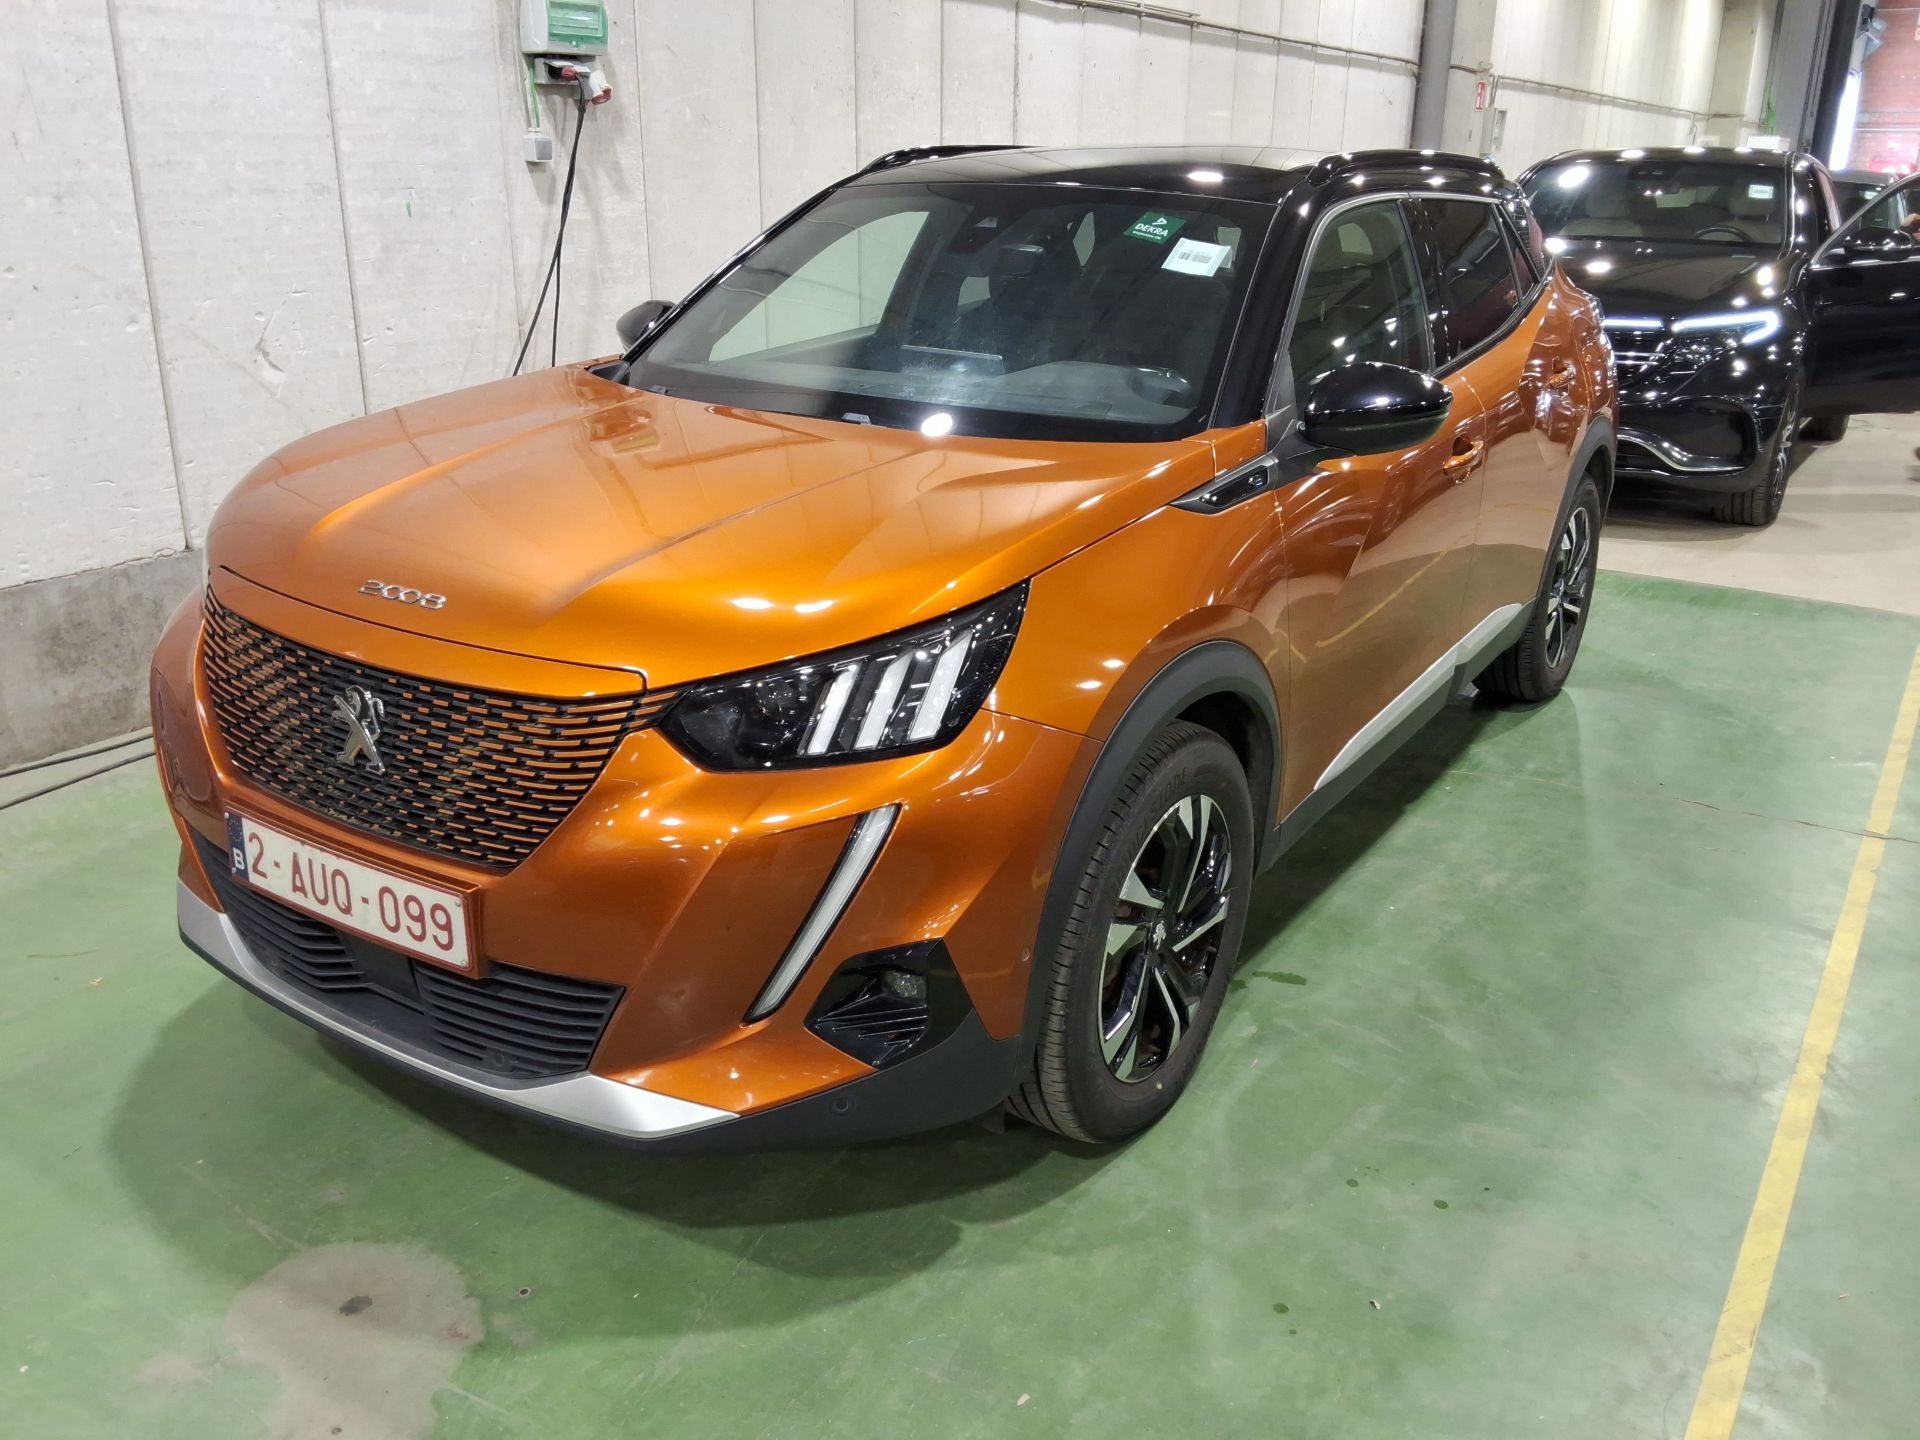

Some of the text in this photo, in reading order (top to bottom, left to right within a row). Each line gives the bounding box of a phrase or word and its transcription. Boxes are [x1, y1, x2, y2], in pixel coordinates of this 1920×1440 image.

[1134, 223, 1169, 237] DEKRA
[358, 579, 448, 610] 2008
[232, 847, 245, 871] B
[248, 831, 454, 952] 2-AUQ-099
